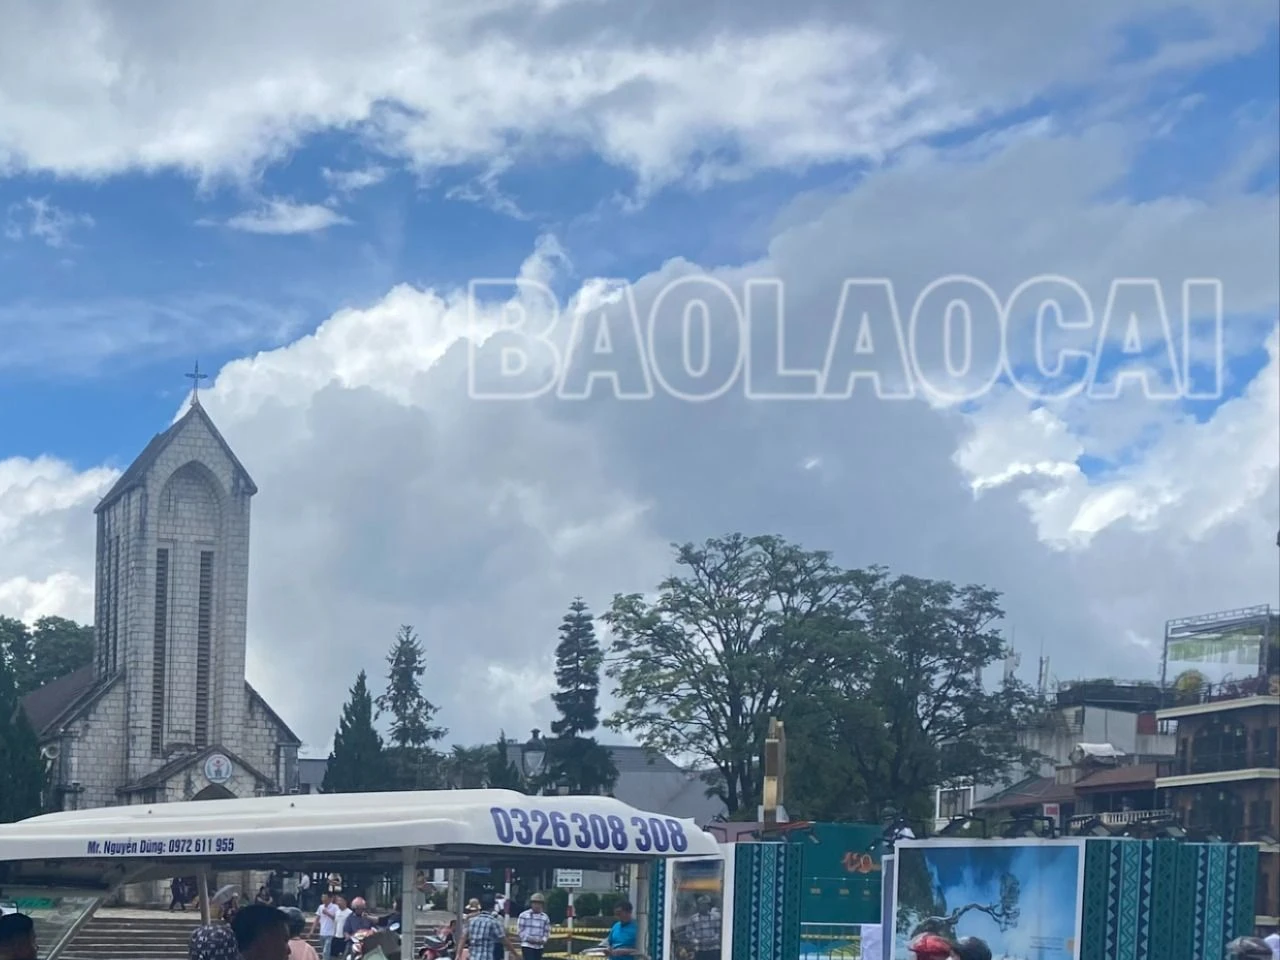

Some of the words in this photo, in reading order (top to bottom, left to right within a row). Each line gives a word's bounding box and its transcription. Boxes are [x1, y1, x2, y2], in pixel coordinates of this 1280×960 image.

[87, 840, 102, 854] Mr.
[168, 839, 192, 853] 0972
[195, 838, 212, 852] 611
[216, 838, 234, 852] 955
[631, 816, 688, 852] 308
